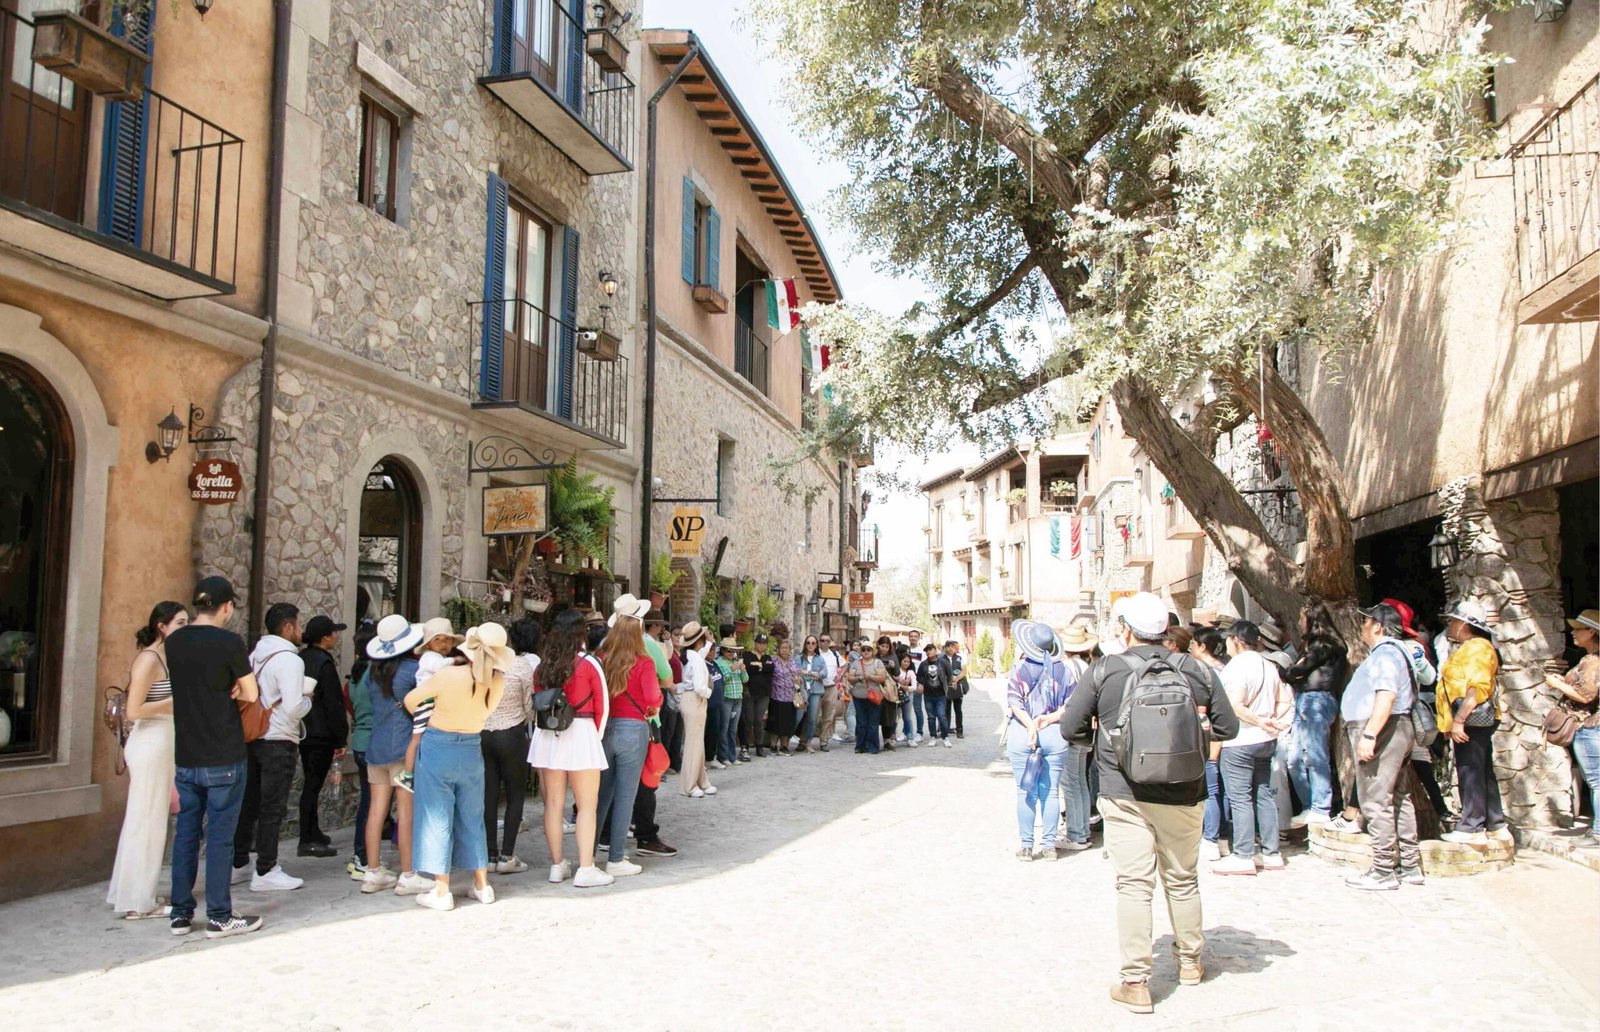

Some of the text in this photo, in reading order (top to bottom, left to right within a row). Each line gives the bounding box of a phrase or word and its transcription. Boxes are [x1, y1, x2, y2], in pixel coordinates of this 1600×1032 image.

[191, 490, 201, 499] 55
[227, 491, 236, 499] 77
[670, 516, 705, 541] SP
